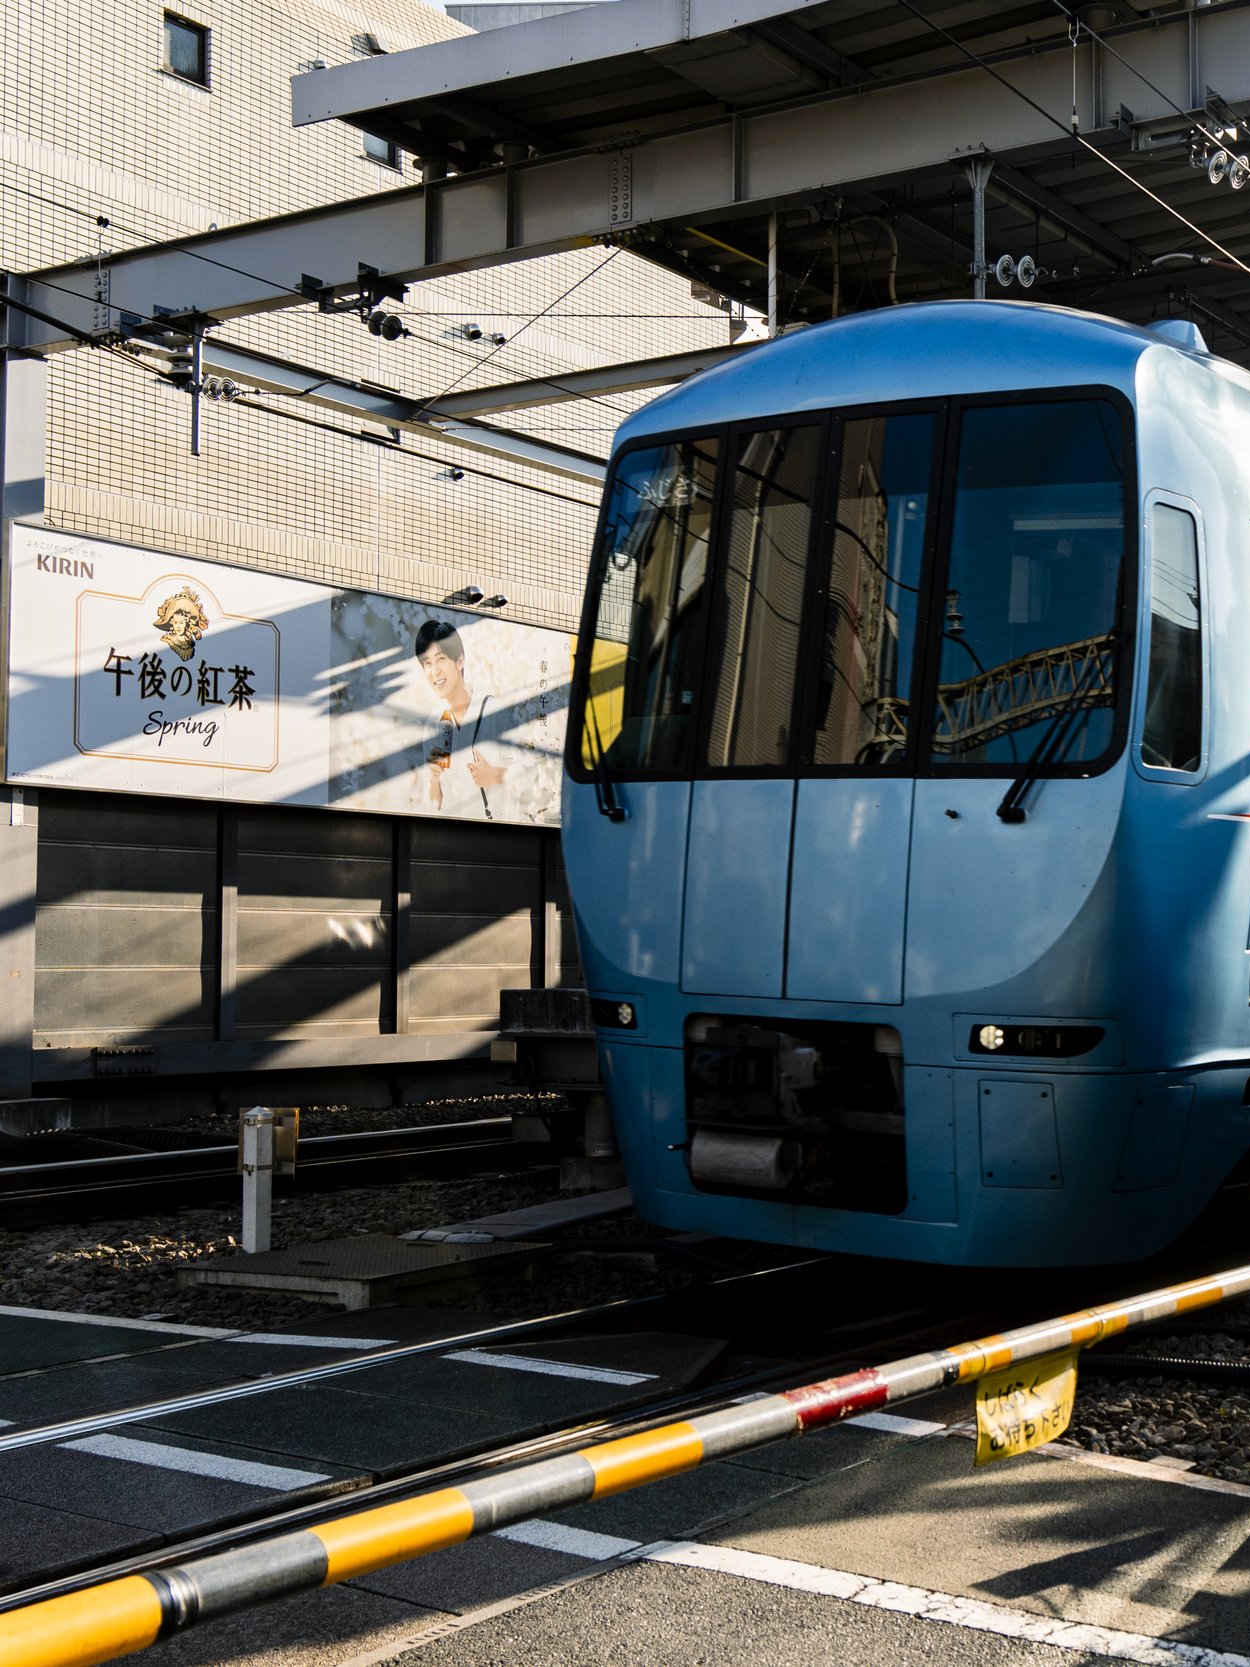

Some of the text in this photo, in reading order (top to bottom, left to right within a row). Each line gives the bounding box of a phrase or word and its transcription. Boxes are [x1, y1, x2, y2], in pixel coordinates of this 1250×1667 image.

[37, 553, 94, 580] KIRIN
[103, 646, 257, 712] 午後の紅茶
[142, 710, 219, 747] Spring
